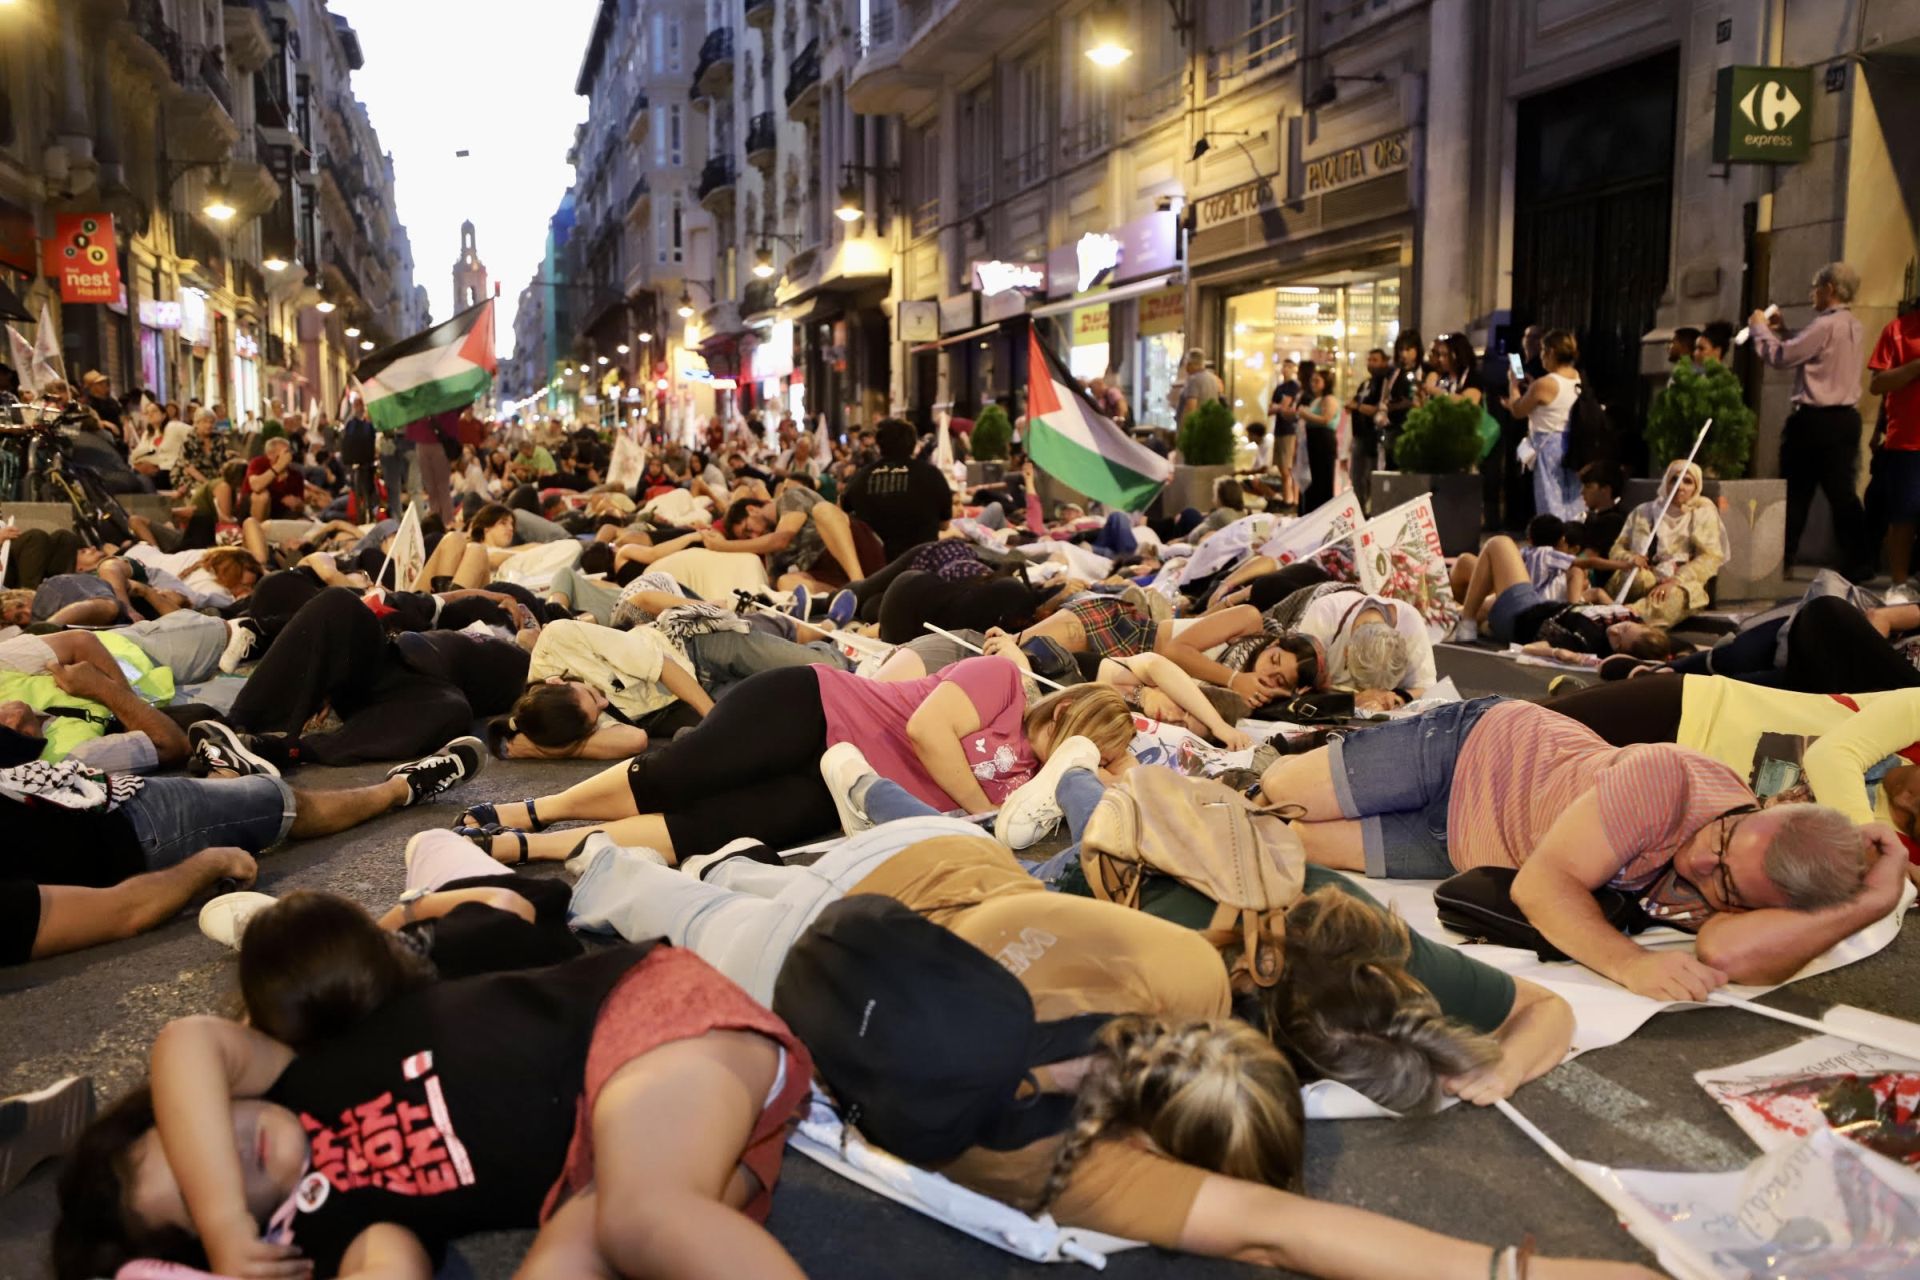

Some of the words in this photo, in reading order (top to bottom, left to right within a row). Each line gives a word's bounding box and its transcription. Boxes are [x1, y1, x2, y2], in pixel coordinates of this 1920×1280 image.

[1744, 134, 1793, 147] express
[1308, 148, 1367, 191] PAQUITA
[1374, 137, 1404, 169] ORS
[67, 271, 112, 286] nest
[1415, 505, 1443, 557] STOP
